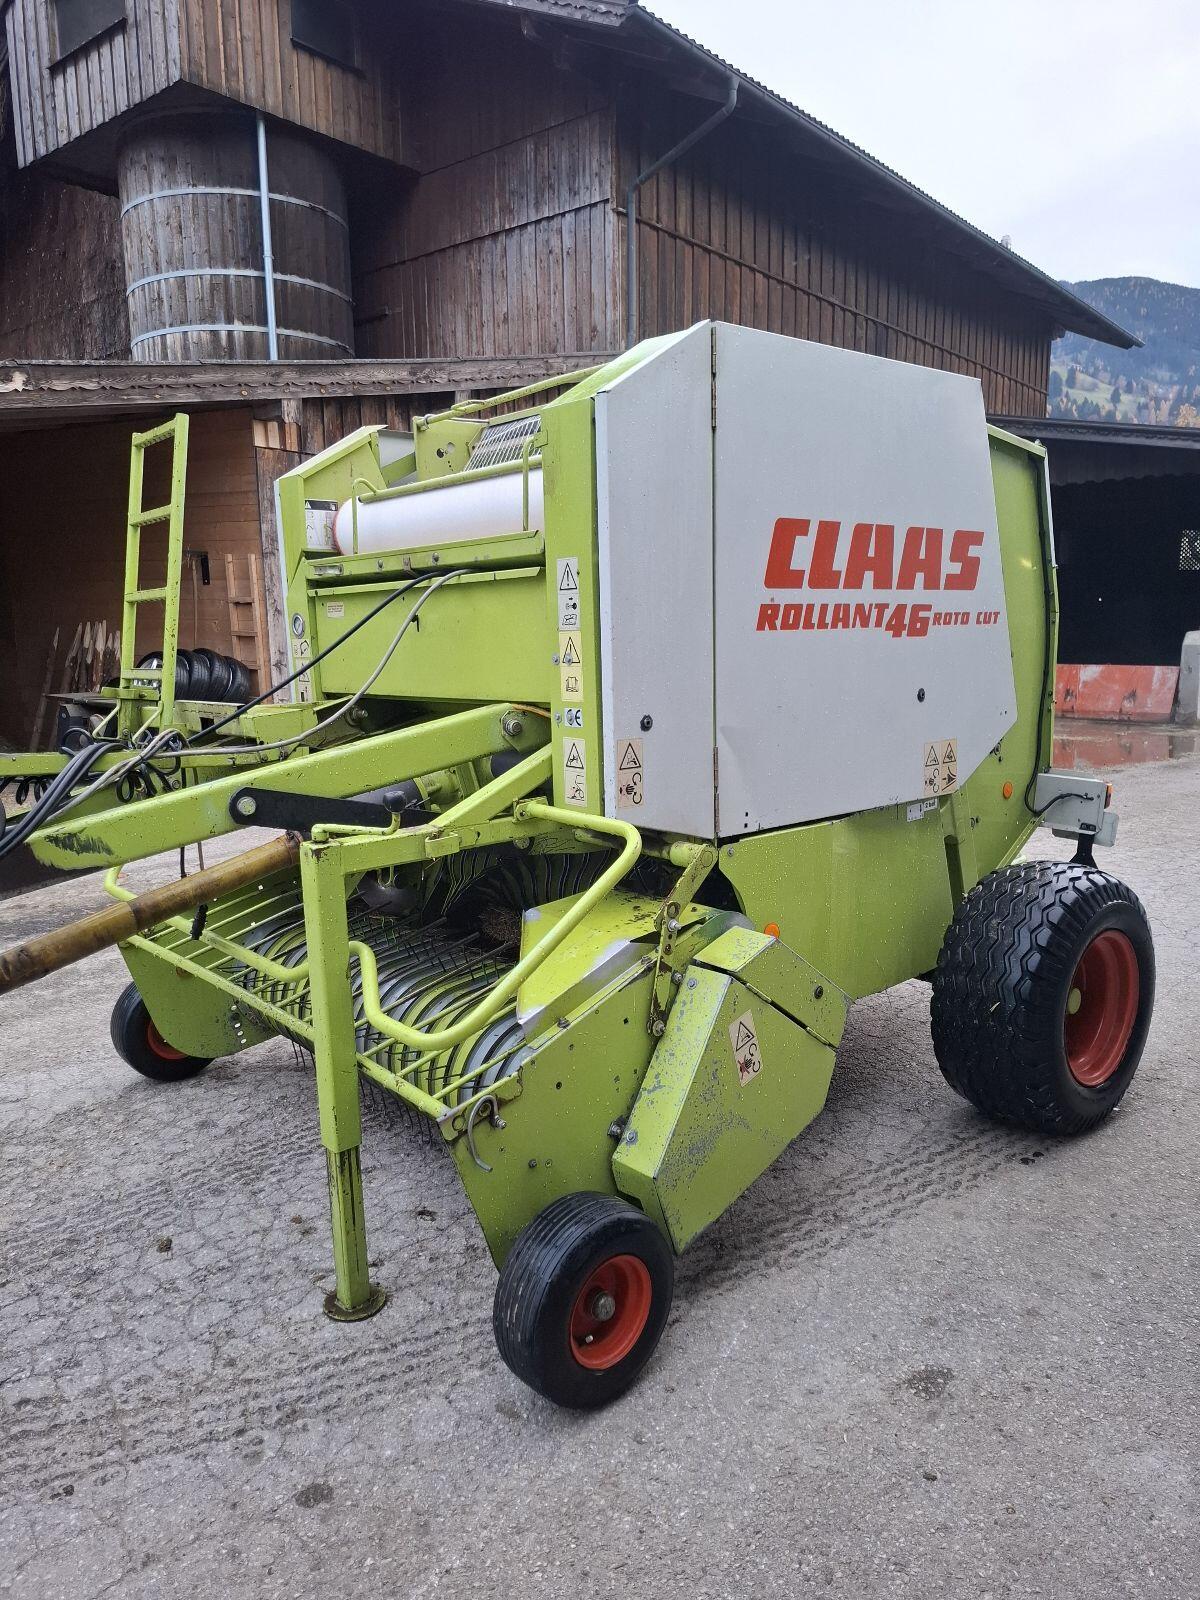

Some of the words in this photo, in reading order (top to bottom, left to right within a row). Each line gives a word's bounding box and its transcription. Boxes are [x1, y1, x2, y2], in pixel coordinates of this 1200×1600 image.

[764, 517, 984, 591] CLAAS
[932, 612, 970, 626] ROTO
[976, 611, 1000, 625] CUT
